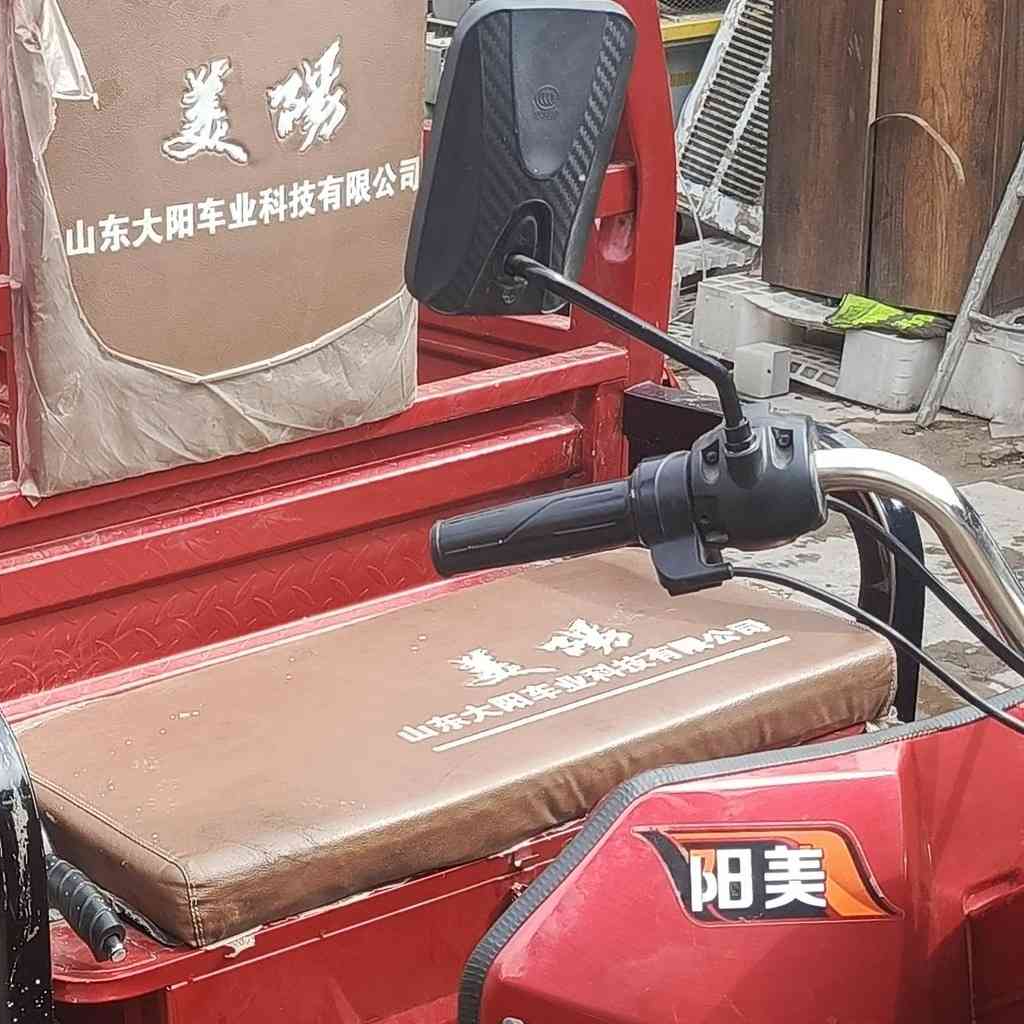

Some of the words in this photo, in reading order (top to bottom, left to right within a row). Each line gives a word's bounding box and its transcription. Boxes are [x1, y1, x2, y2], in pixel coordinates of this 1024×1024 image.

[66, 156, 419, 255] 山东大阳车业科技有限公司
[397, 617, 772, 743] 山东大阳车业科技有限公司
[690, 845, 826, 912] 阳美
